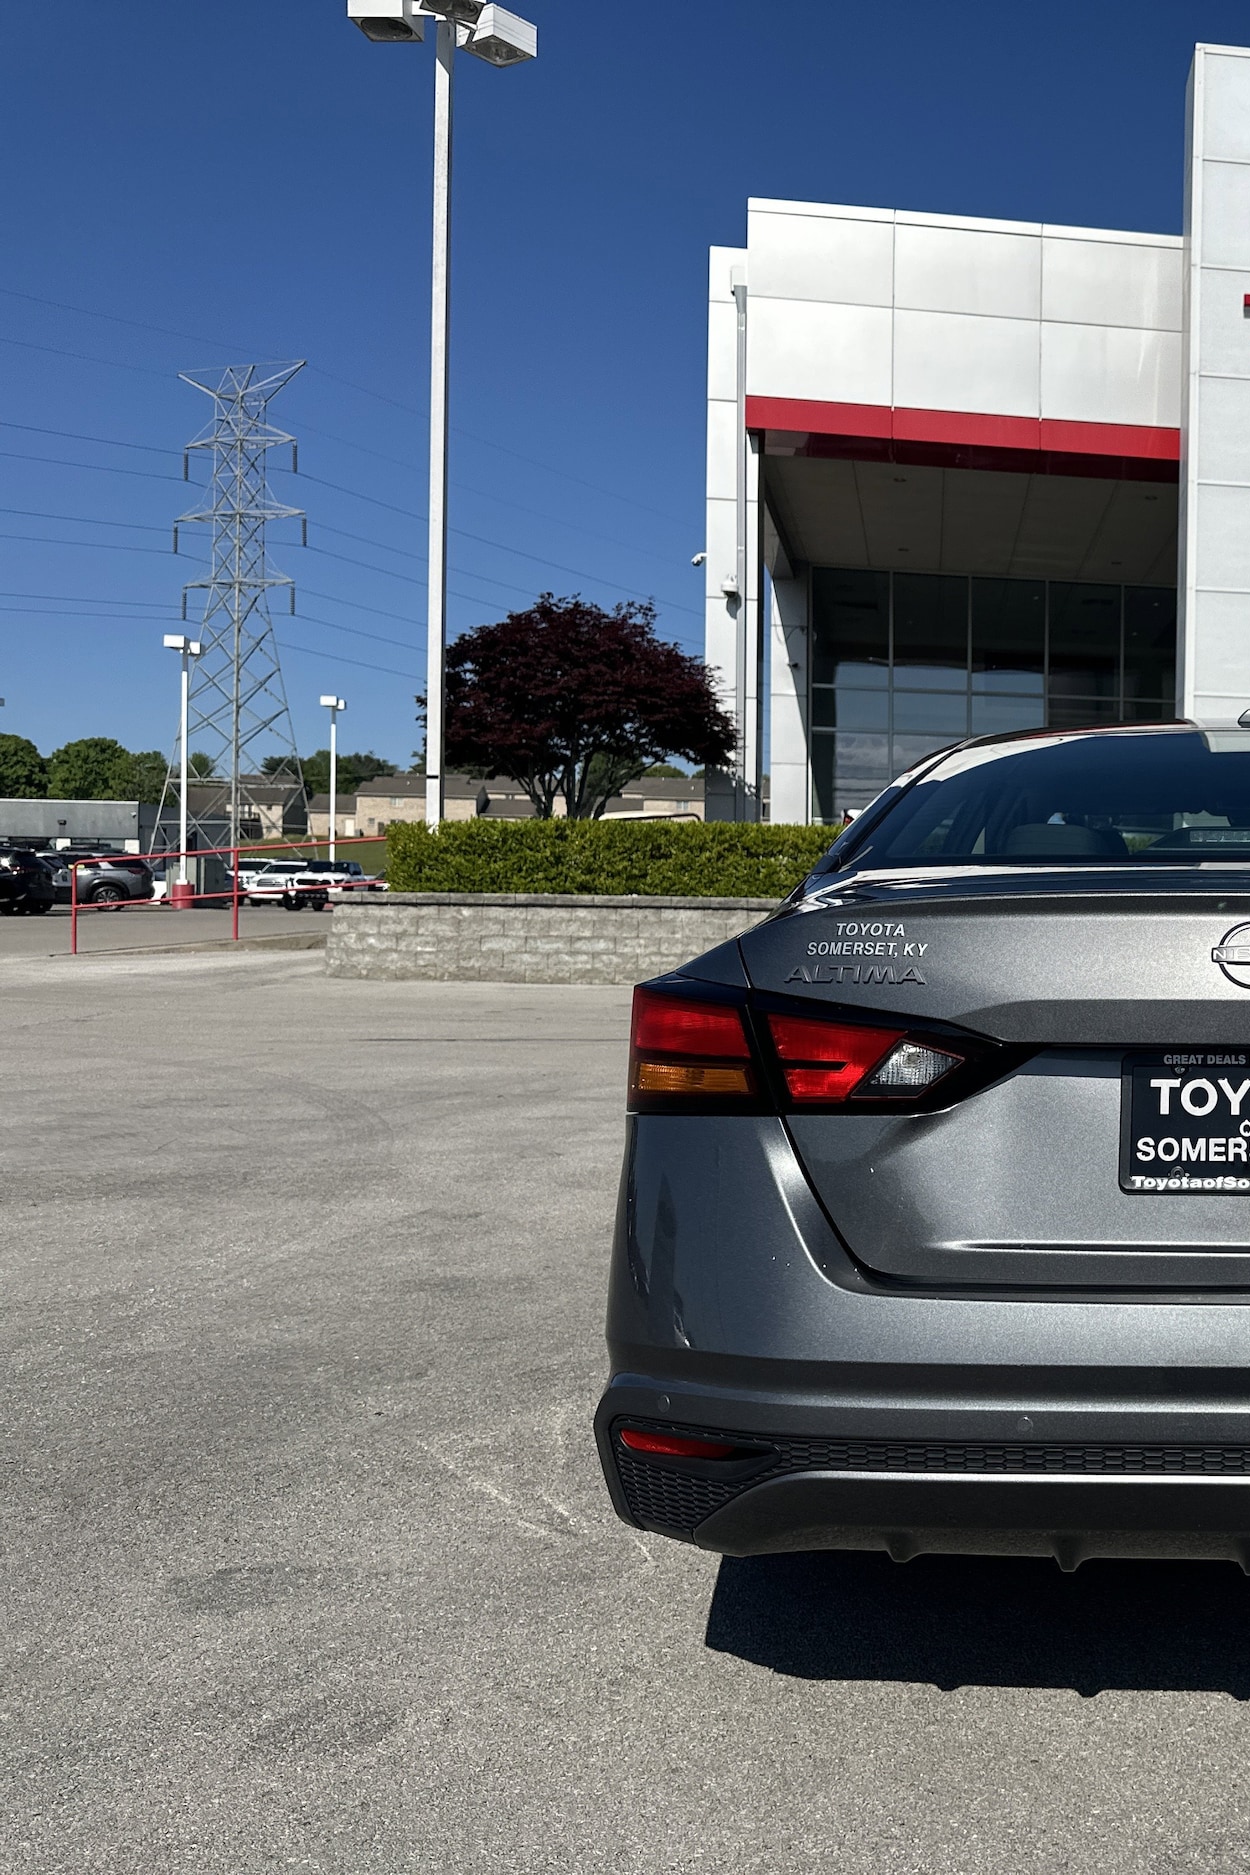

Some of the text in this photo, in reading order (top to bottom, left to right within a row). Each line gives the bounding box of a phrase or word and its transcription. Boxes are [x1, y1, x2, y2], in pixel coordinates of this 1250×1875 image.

[836, 922, 906, 937] TOYOTA
[807, 941, 929, 958] SOMERSET, KY
[784, 964, 928, 985] ALTIMA
[1163, 1054, 1204, 1065] GREAT
